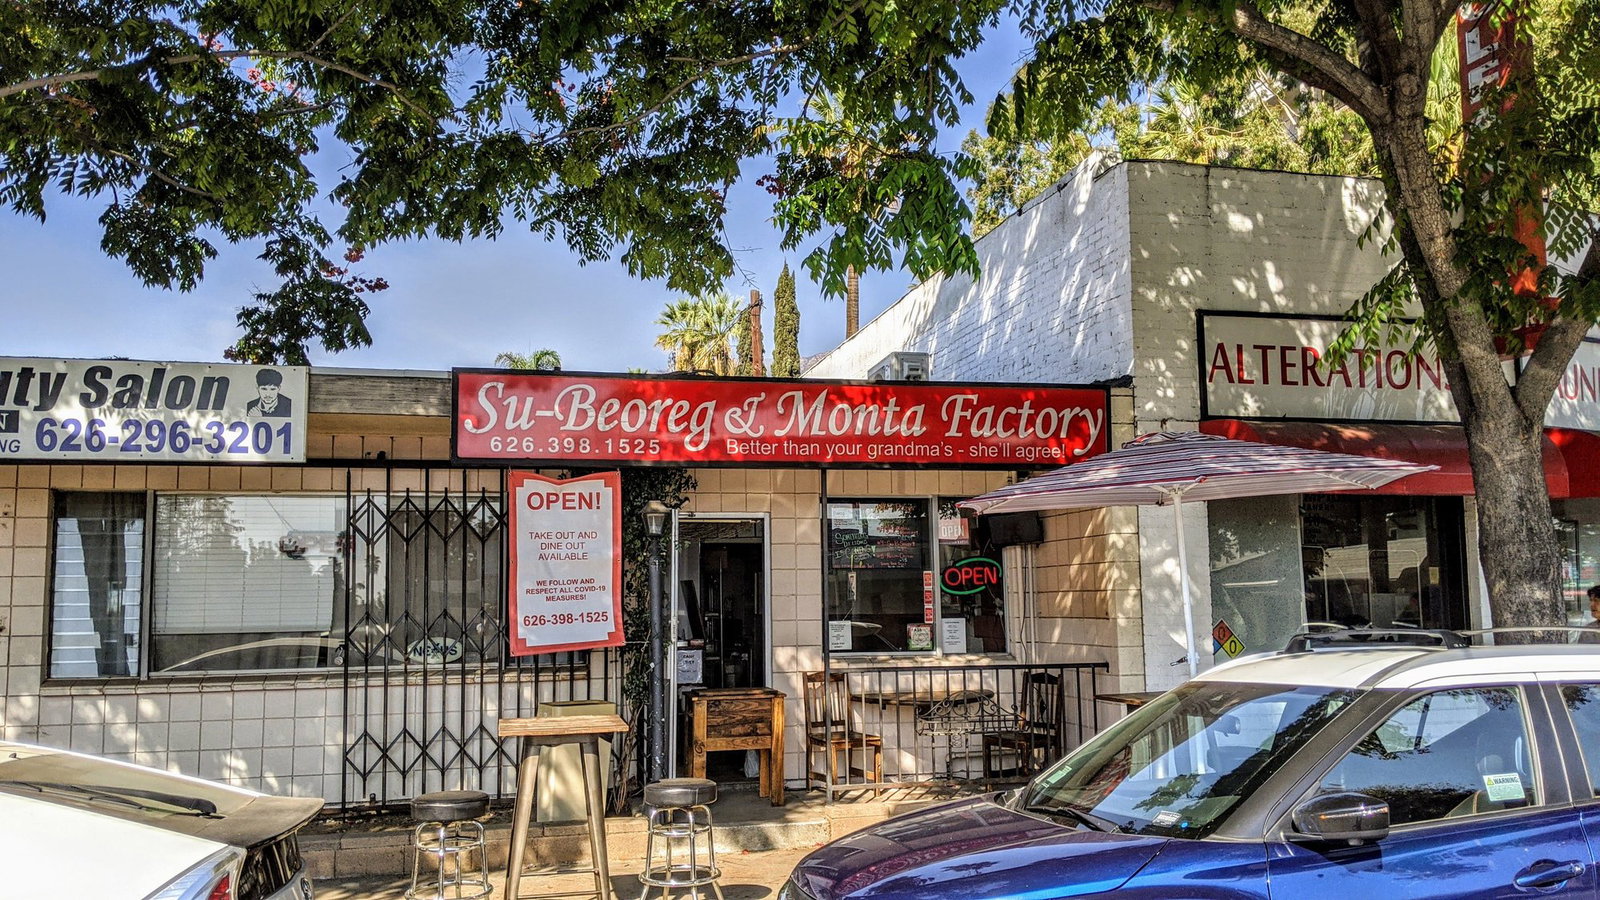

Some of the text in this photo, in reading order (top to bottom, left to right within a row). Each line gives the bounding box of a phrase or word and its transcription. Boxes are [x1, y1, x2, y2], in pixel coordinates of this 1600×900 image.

[1208, 342, 1451, 391] ALTERATION
[79, 365, 230, 411] Salon
[464, 381, 1103, 457] Su-Beoreg & Monta Factory
[35, 417, 292, 455] 626-296-3201
[490, 436, 661, 455] 626.398.1525
[726, 438, 778, 455] Better
[783, 440, 820, 456] than
[825, 443, 863, 459] your
[867, 441, 953, 459] grandma's
[969, 442, 1010, 458] she'll
[1015, 444, 1066, 461] agree!
[526, 491, 601, 510] OPEN!
[529, 531, 598, 540] TAKE OUT AND
[540, 541, 586, 550] DINE OUT
[538, 552, 589, 561] AVAILABLE
[536, 577, 595, 587] WE FOLLOW AND
[944, 566, 997, 586] OPEN
[525, 585, 606, 595] RESPECT ALL COVID-19
[545, 594, 587, 602] MEASURES!
[523, 611, 609, 627] 626-398-1525
[1229, 639, 1237, 654] 0
